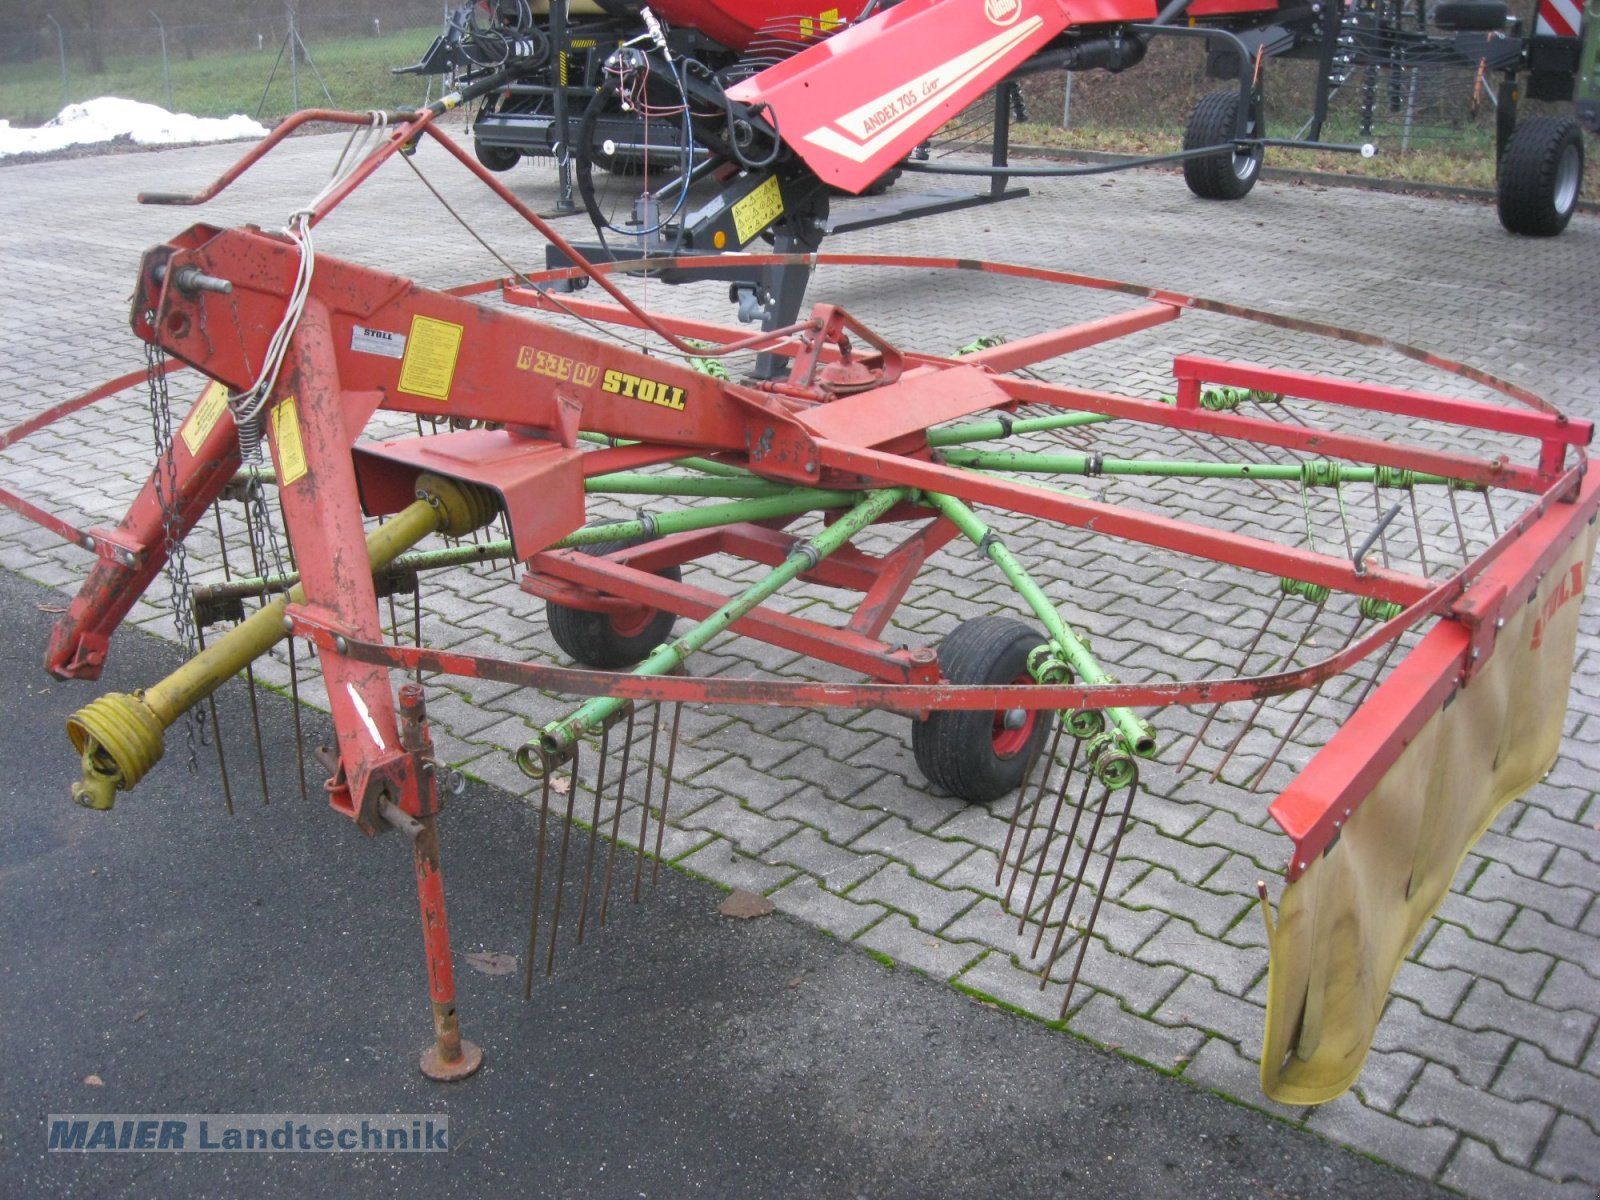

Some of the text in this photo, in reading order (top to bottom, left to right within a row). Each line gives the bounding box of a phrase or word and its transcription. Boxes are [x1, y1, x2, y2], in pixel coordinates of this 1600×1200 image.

[863, 102, 900, 134] ANDEX
[897, 90, 917, 111] 705
[364, 328, 393, 341] STOLL
[533, 351, 573, 380] 335
[602, 368, 686, 411] STOLL
